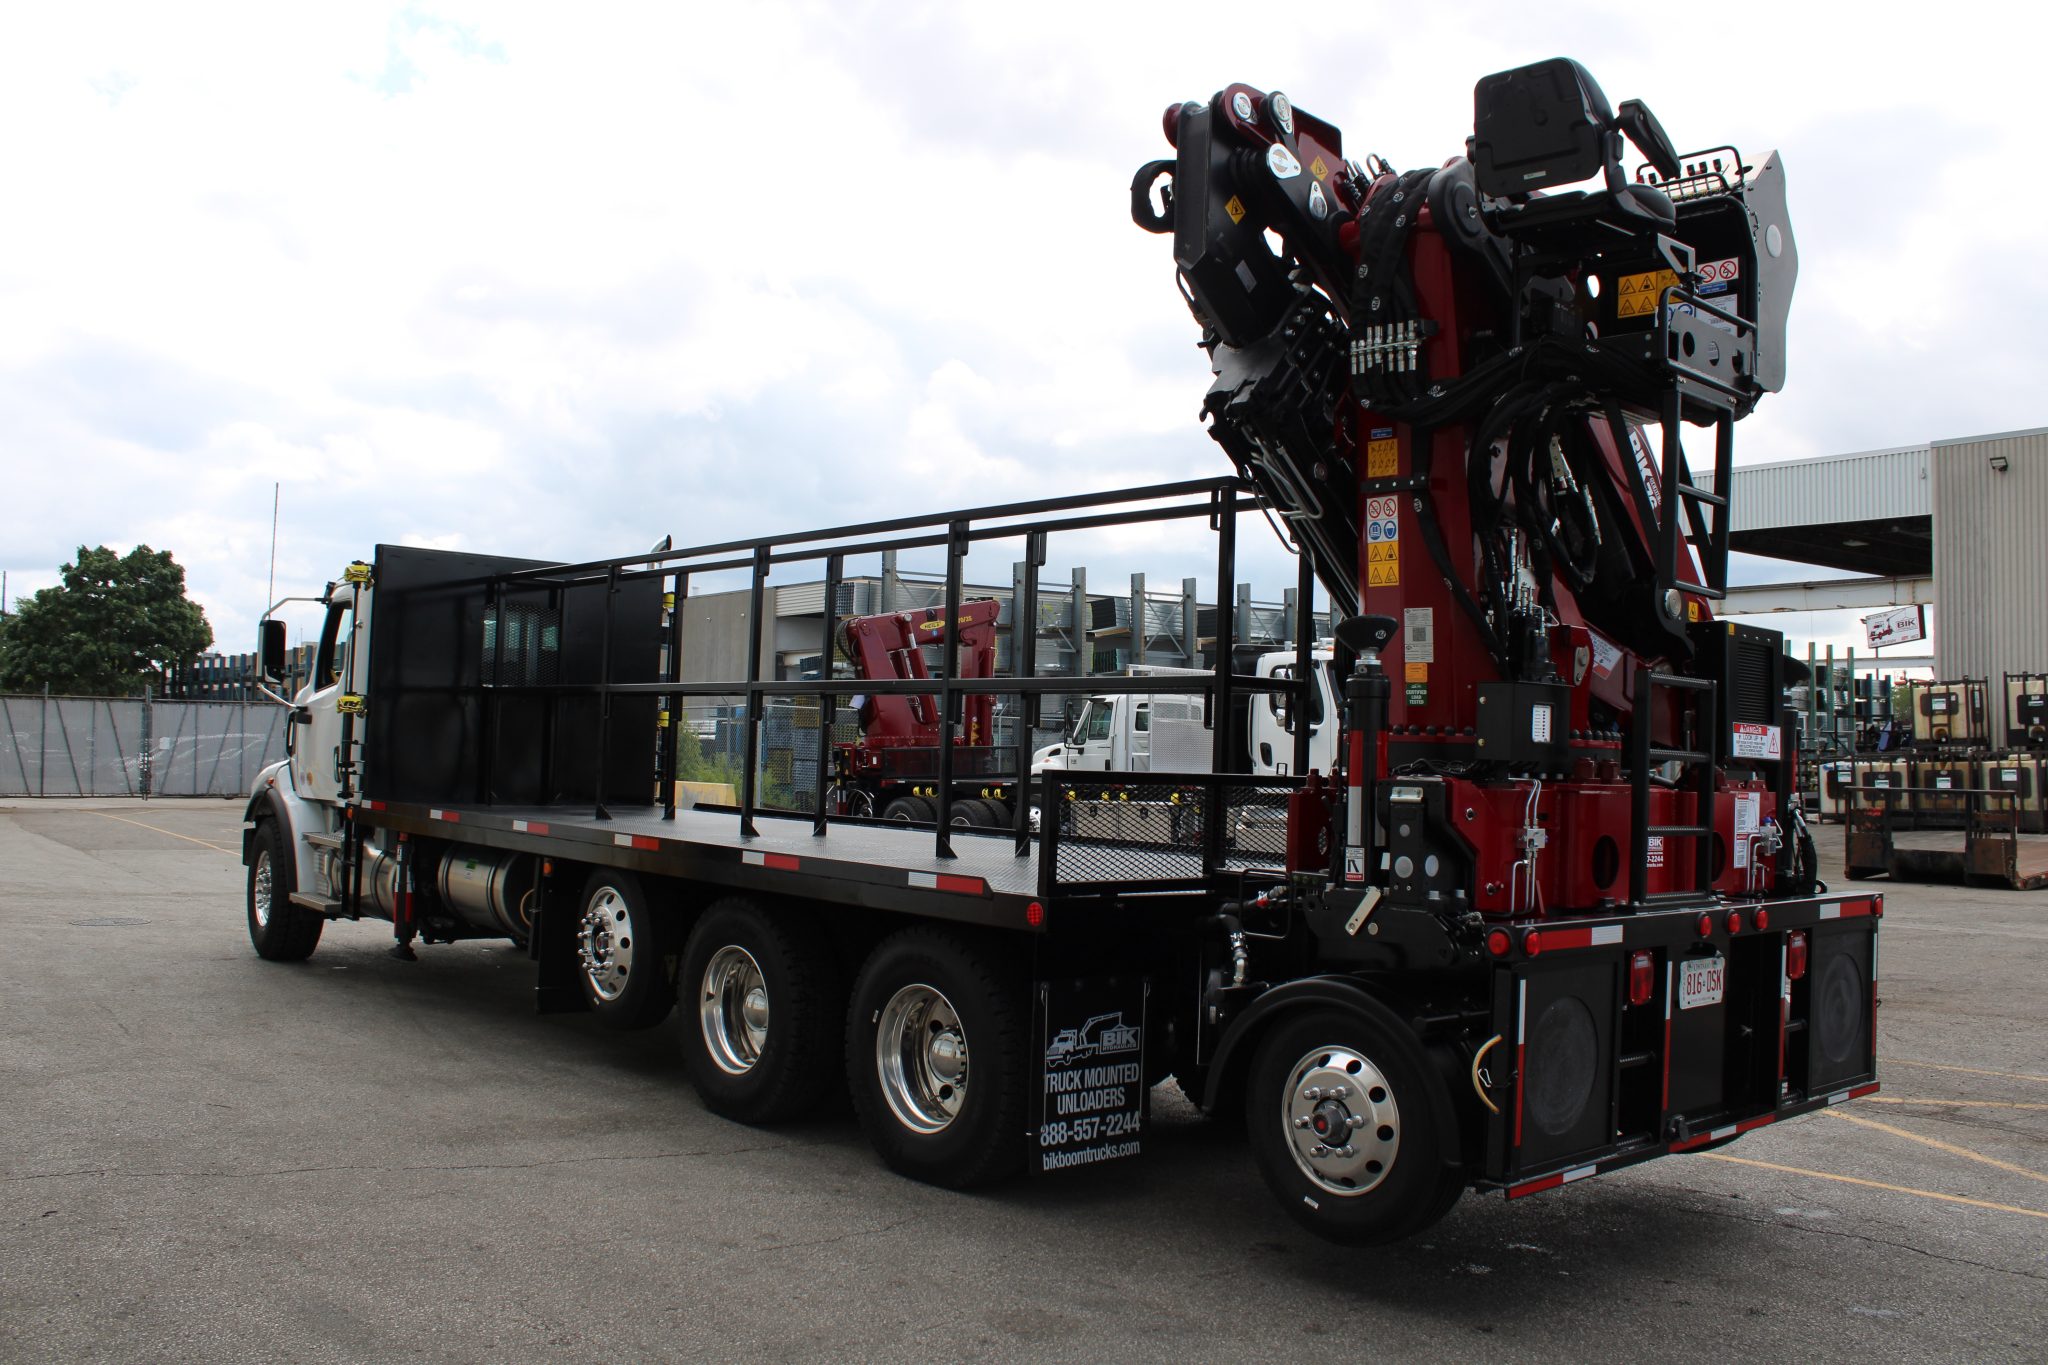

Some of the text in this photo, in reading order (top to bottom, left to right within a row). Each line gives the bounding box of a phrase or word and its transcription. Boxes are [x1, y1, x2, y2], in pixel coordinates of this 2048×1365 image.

[1897, 619, 1915, 628] BIK
[1648, 838, 1662, 846] BIK
[1103, 1030, 1136, 1046] BIK
[1045, 1063, 1139, 1094] TRUCK MOUNTED
[1057, 1088, 1125, 1115] UNLOADERS
[1040, 1111, 1140, 1146] 888-557-2244
[1043, 1141, 1140, 1171] bikboomtrucks.com
